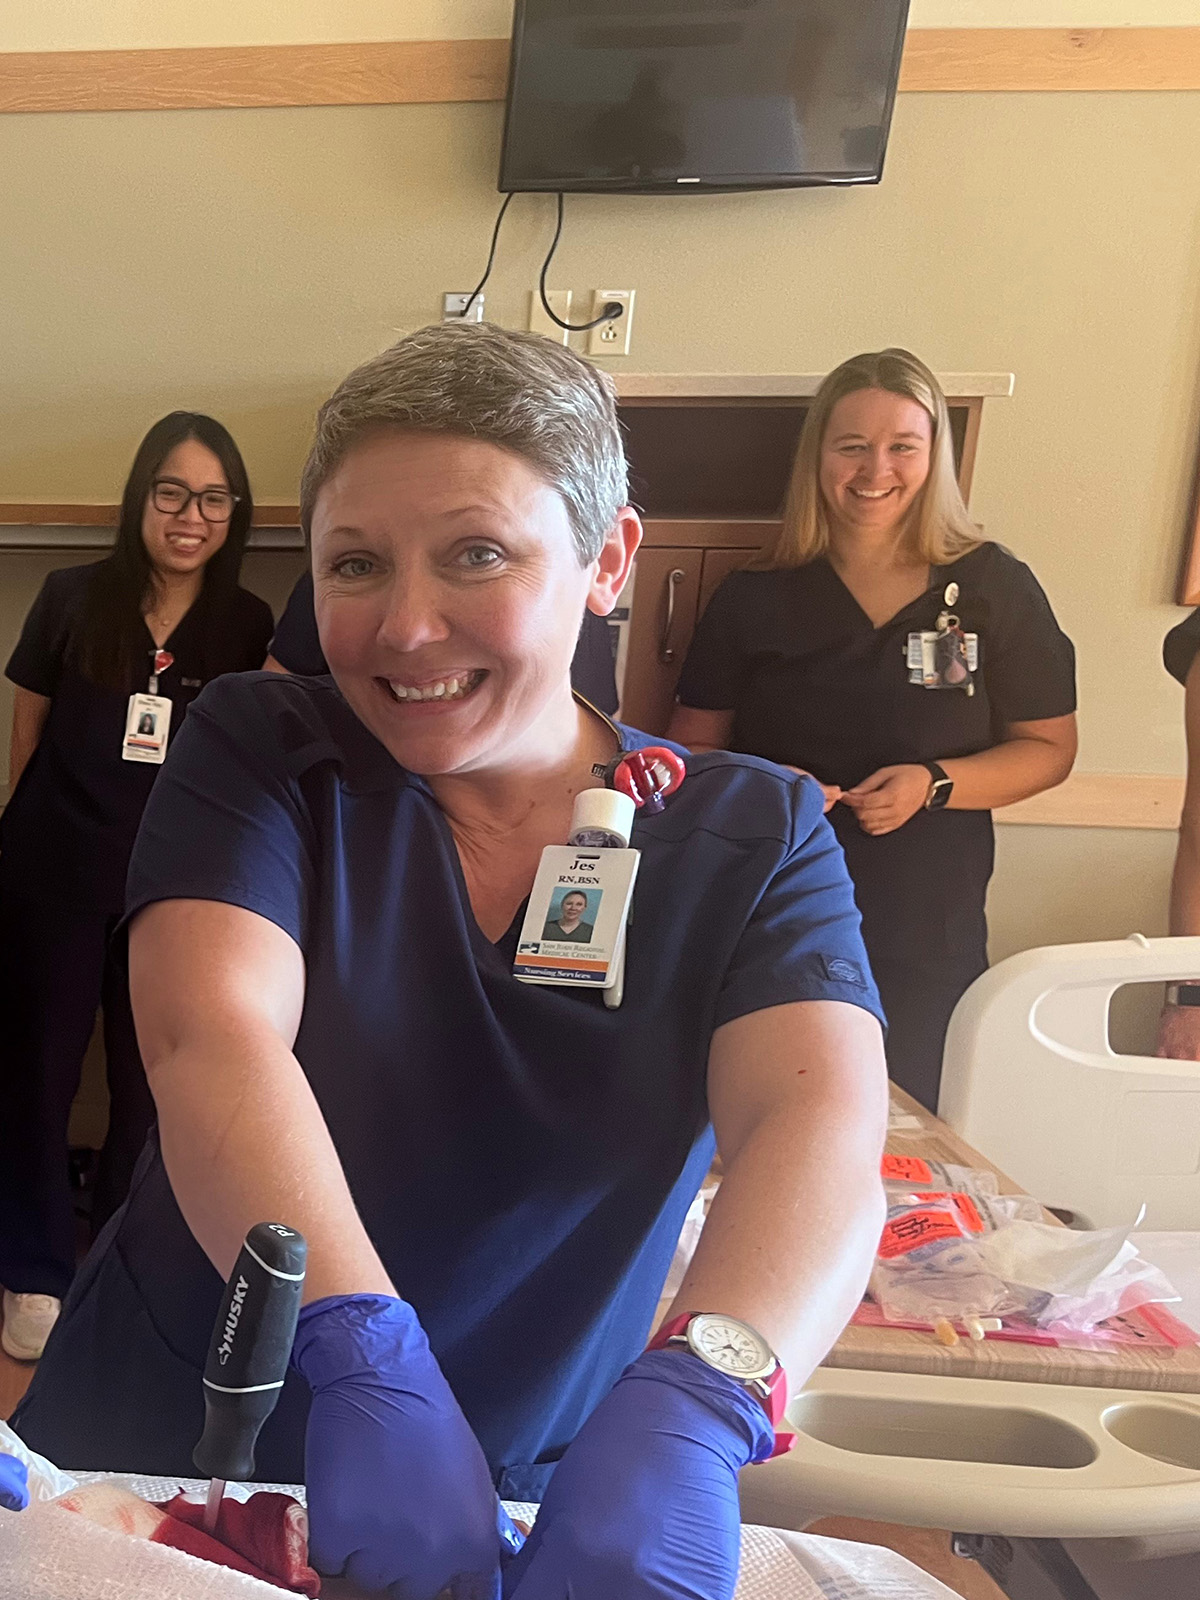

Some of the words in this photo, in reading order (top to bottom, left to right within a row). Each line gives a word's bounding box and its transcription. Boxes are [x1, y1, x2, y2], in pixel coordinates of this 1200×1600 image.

[569, 860, 596, 871] Jes
[558, 875, 601, 885] RN,BSN
[524, 967, 557, 977] Nursing
[557, 970, 591, 979] Services
[223, 1275, 250, 1343] HUSKY
